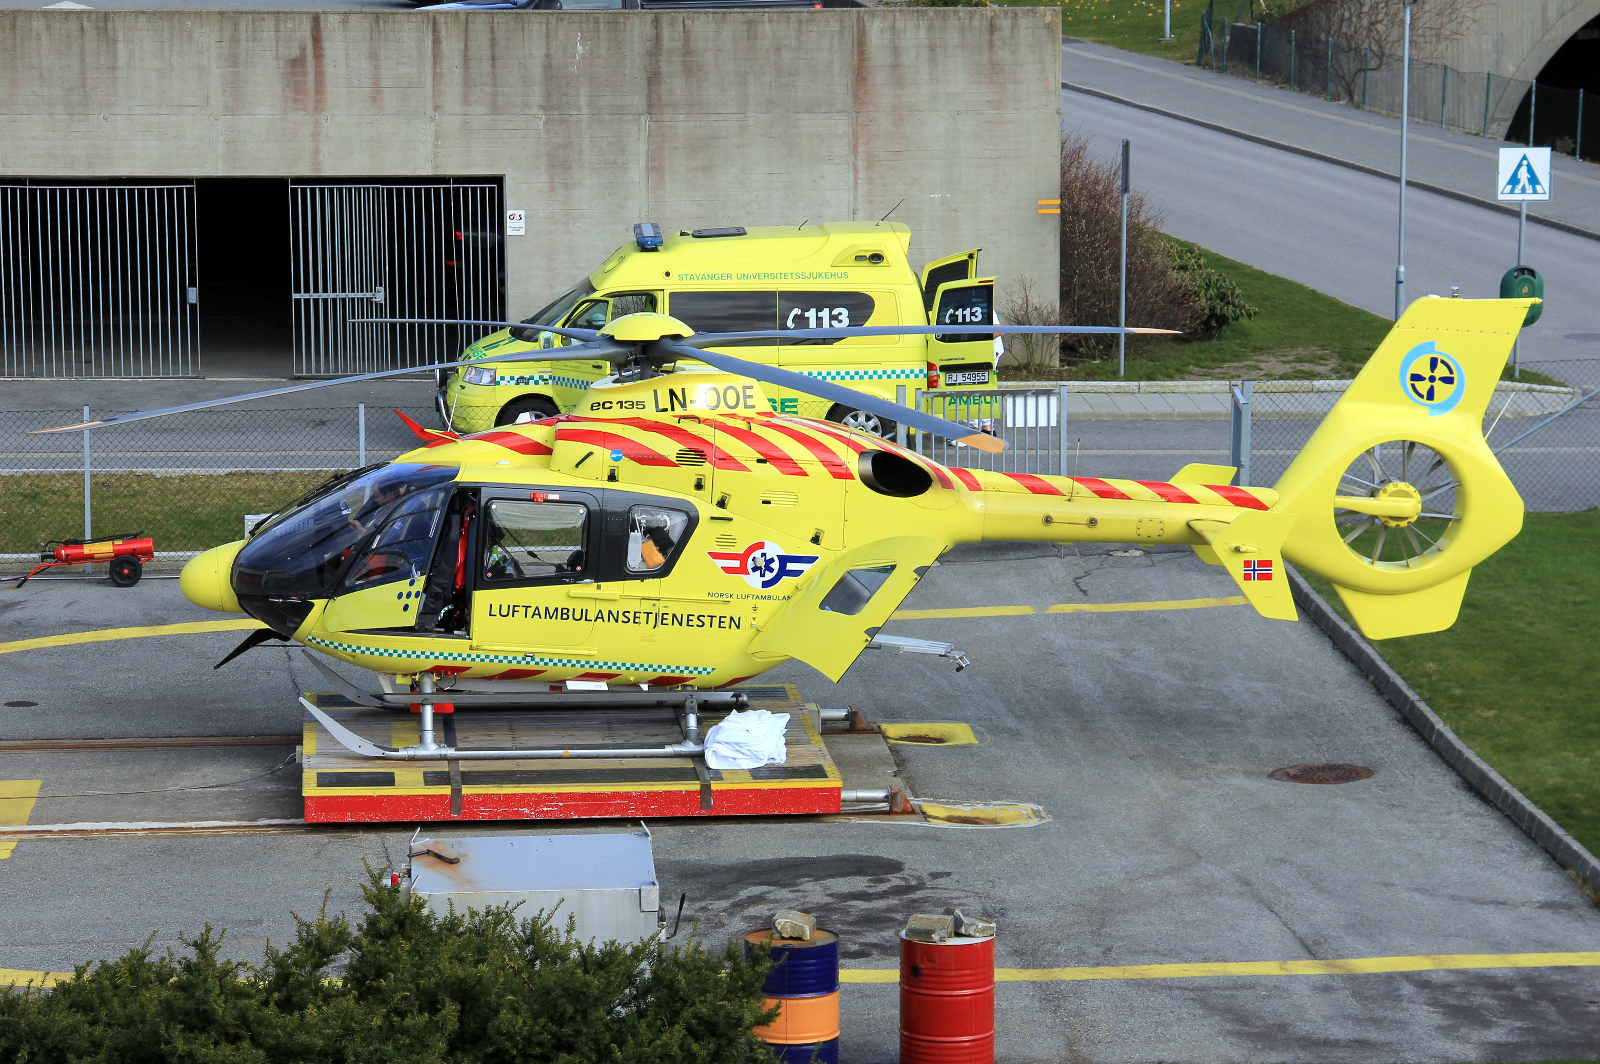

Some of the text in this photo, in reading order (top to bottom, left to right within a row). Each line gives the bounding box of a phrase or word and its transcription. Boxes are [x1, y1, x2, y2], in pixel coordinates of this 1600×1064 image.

[678, 271, 849, 281] STAVANGER UNIVERSITETSSJUKEHUS
[804, 307, 850, 329] 113
[955, 306, 982, 323] 113
[947, 372, 986, 383] RJ 54955
[616, 400, 646, 410] 135
[653, 385, 756, 412] LN-OOE
[488, 603, 741, 629] LUFTAMBULANSETJENESTEN
